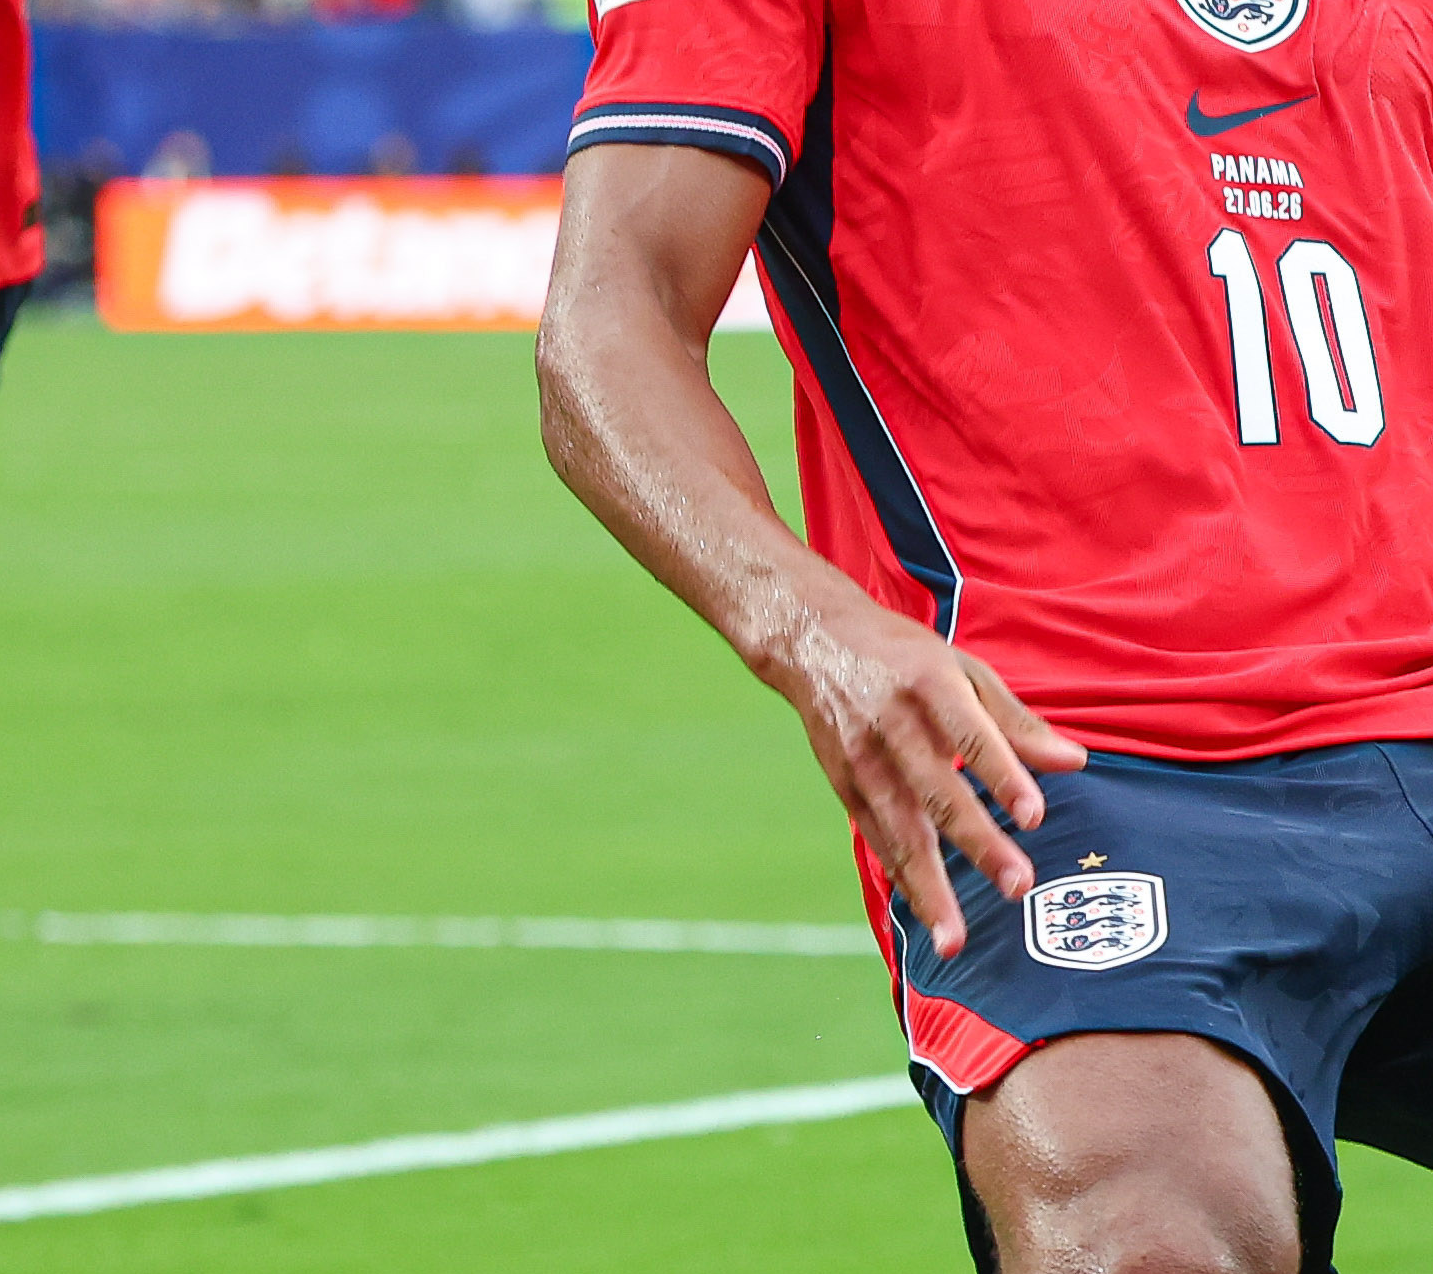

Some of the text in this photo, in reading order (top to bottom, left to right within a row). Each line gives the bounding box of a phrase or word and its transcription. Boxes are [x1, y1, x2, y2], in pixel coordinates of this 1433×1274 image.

[1210, 152, 1304, 189] PANAMA
[1222, 186, 1304, 221] 27.06.26
[1207, 226, 1386, 448] 10
